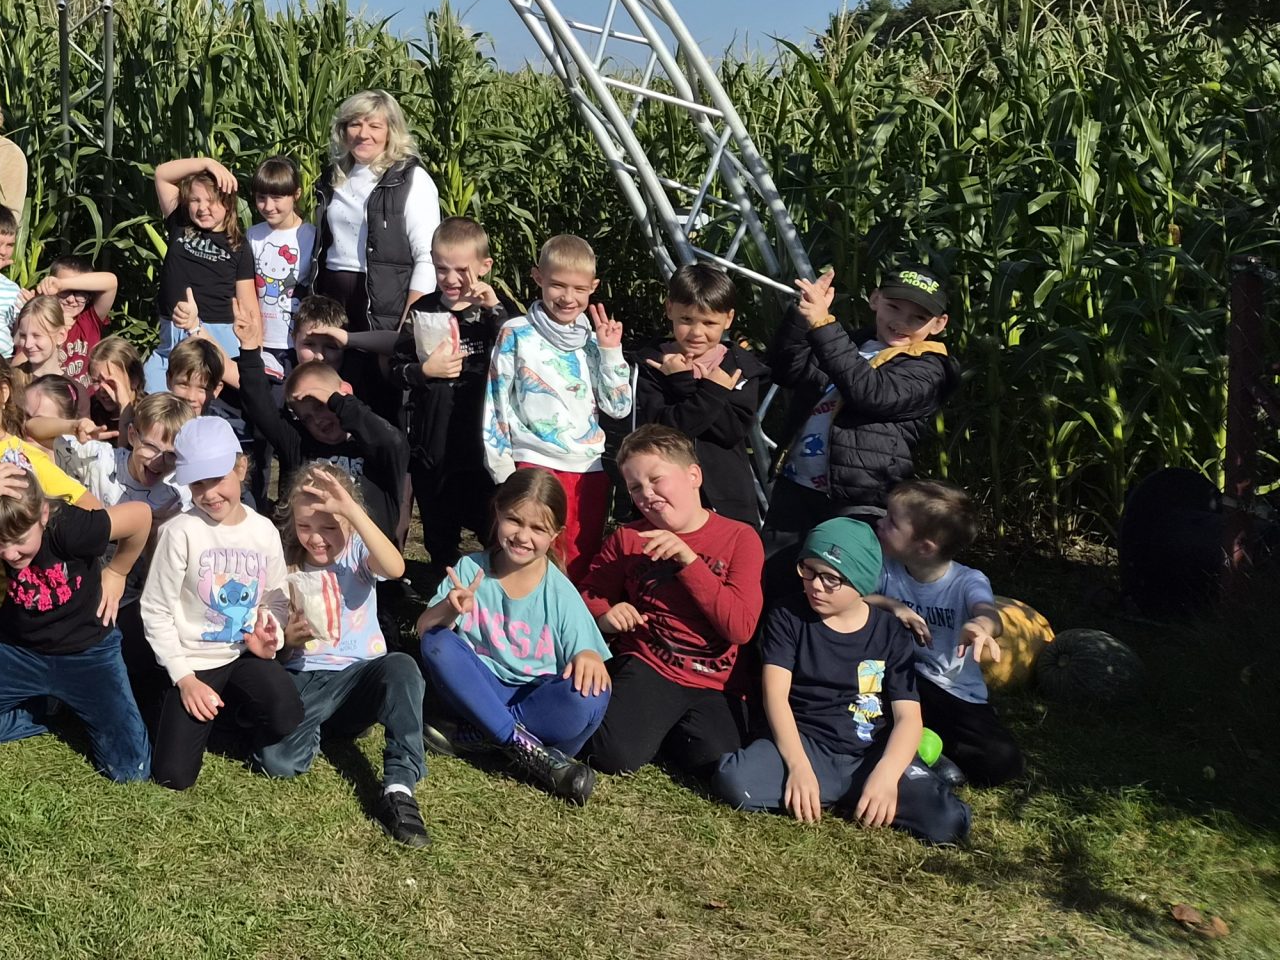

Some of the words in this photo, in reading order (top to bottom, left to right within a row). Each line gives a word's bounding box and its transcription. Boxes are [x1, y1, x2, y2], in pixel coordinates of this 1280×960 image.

[899, 270, 940, 291] GAME
[902, 278, 938, 295] MODE
[198, 548, 268, 579] STITCH
